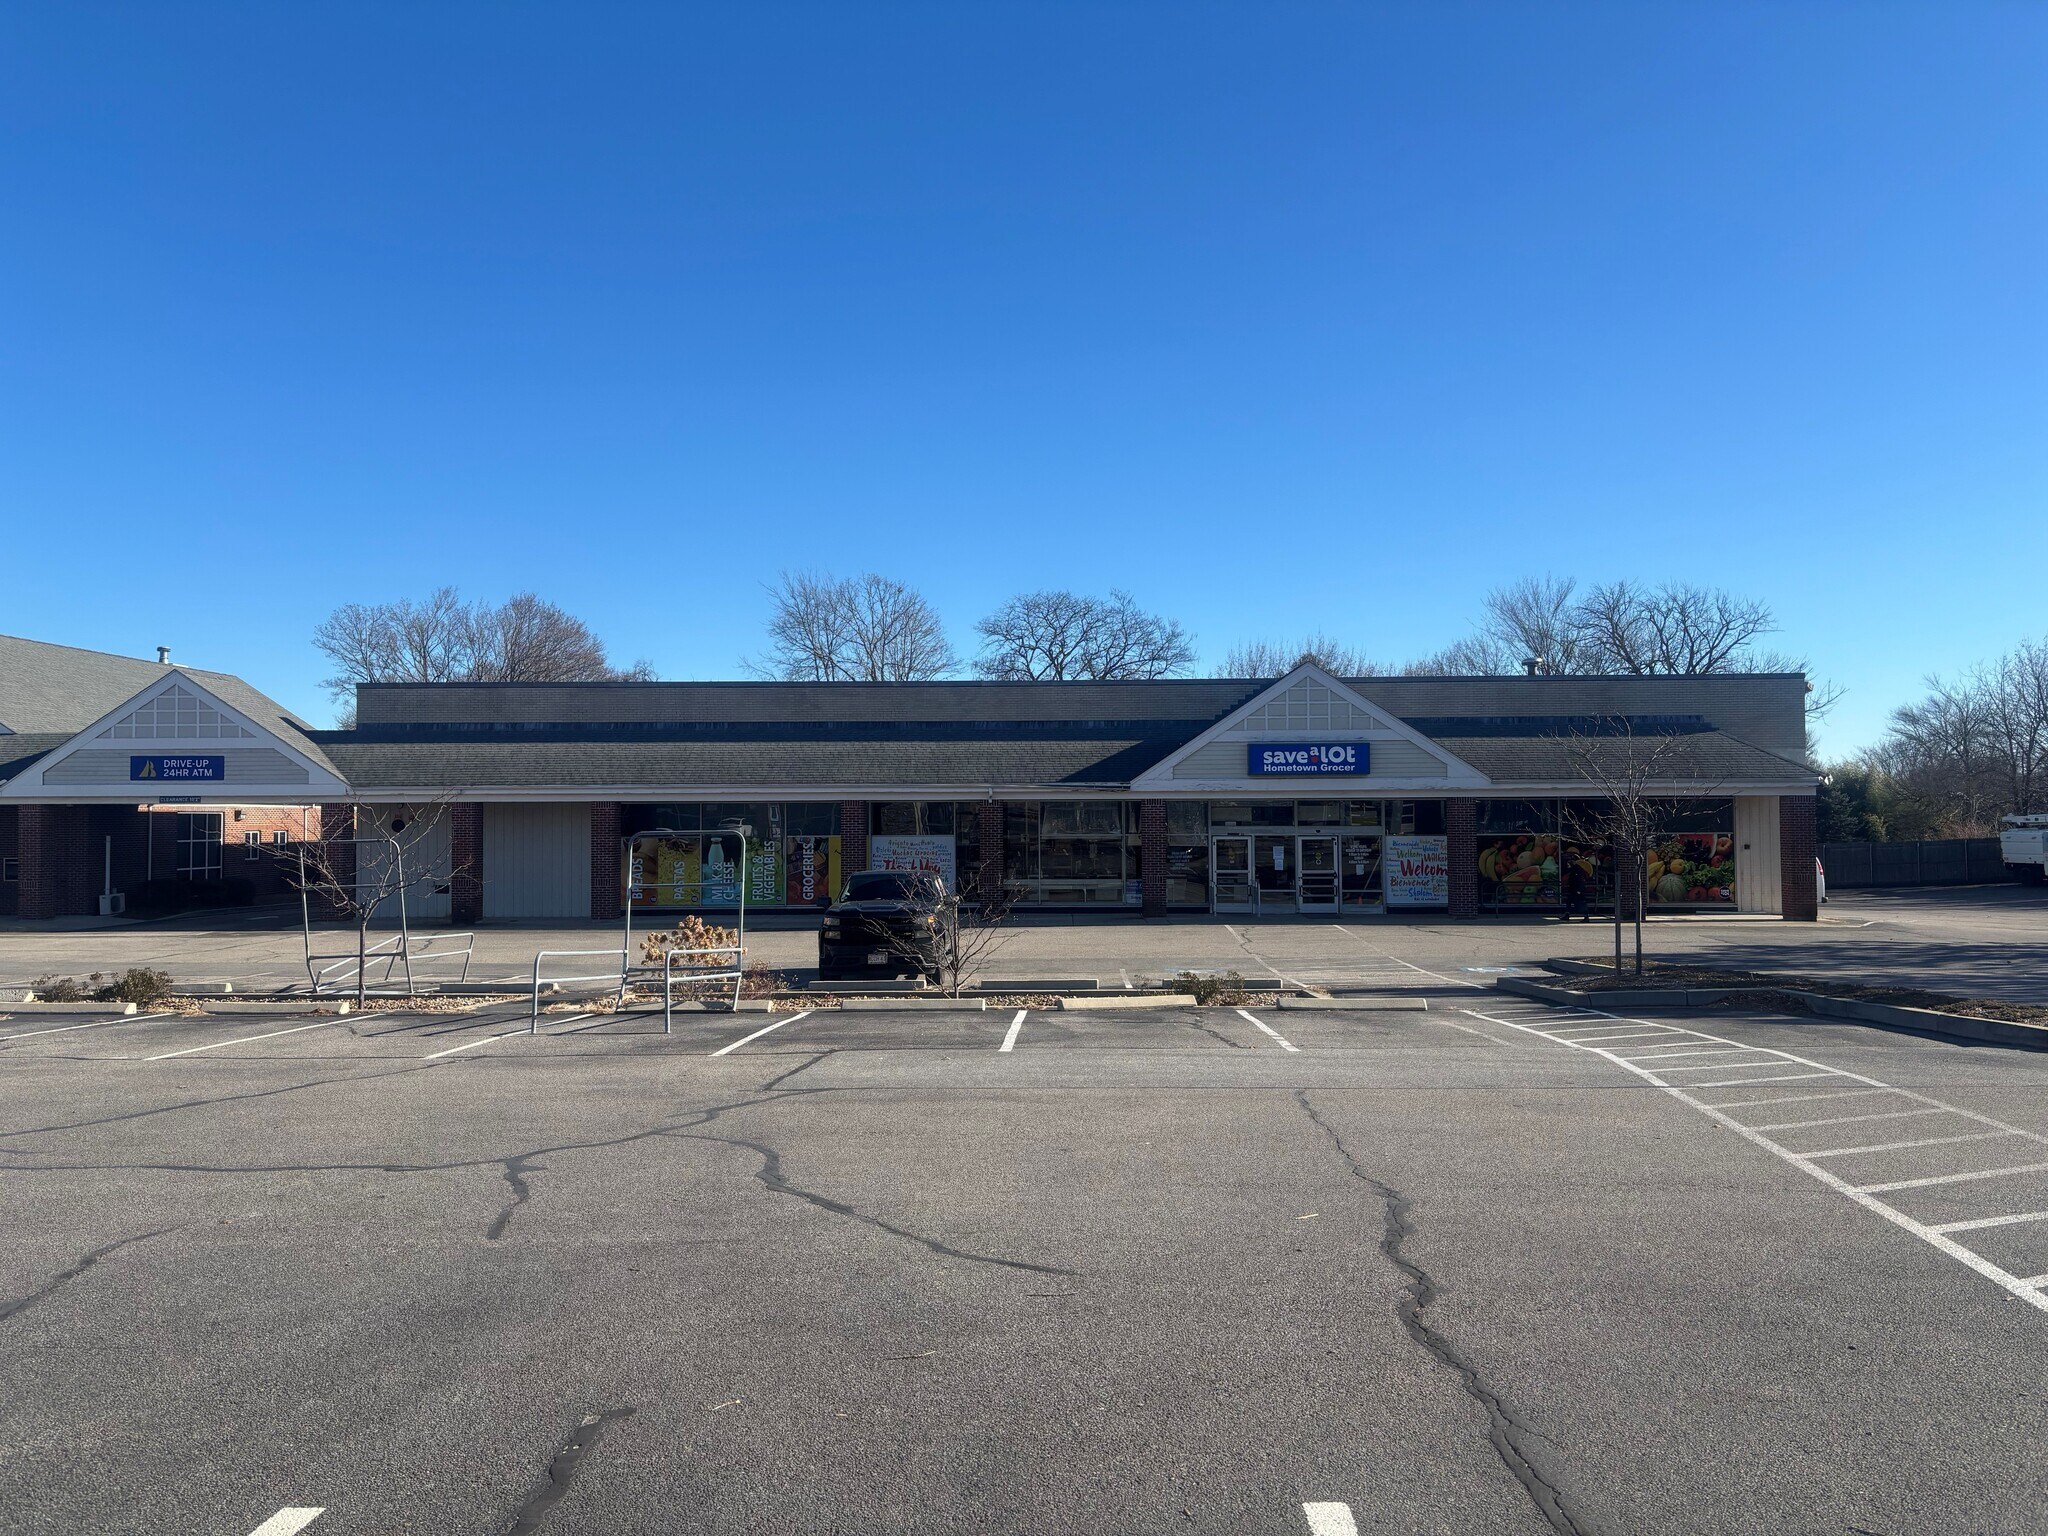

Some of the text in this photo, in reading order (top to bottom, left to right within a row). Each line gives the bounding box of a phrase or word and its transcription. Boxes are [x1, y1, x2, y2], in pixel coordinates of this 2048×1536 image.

[163, 759, 209, 768] DRIVE-UP
[1263, 751, 1308, 764] save
[1264, 764, 1355, 772] Hometown Grocer
[163, 768, 213, 777] 24HR ATM
[673, 861, 685, 900] PASTAS
[723, 861, 735, 900] CHEESE
[752, 855, 764, 901] FRUITS &
[763, 840, 775, 901] VEGETABLES
[803, 842, 815, 901] GROCERIES
[1400, 859, 1448, 876] Welcom
